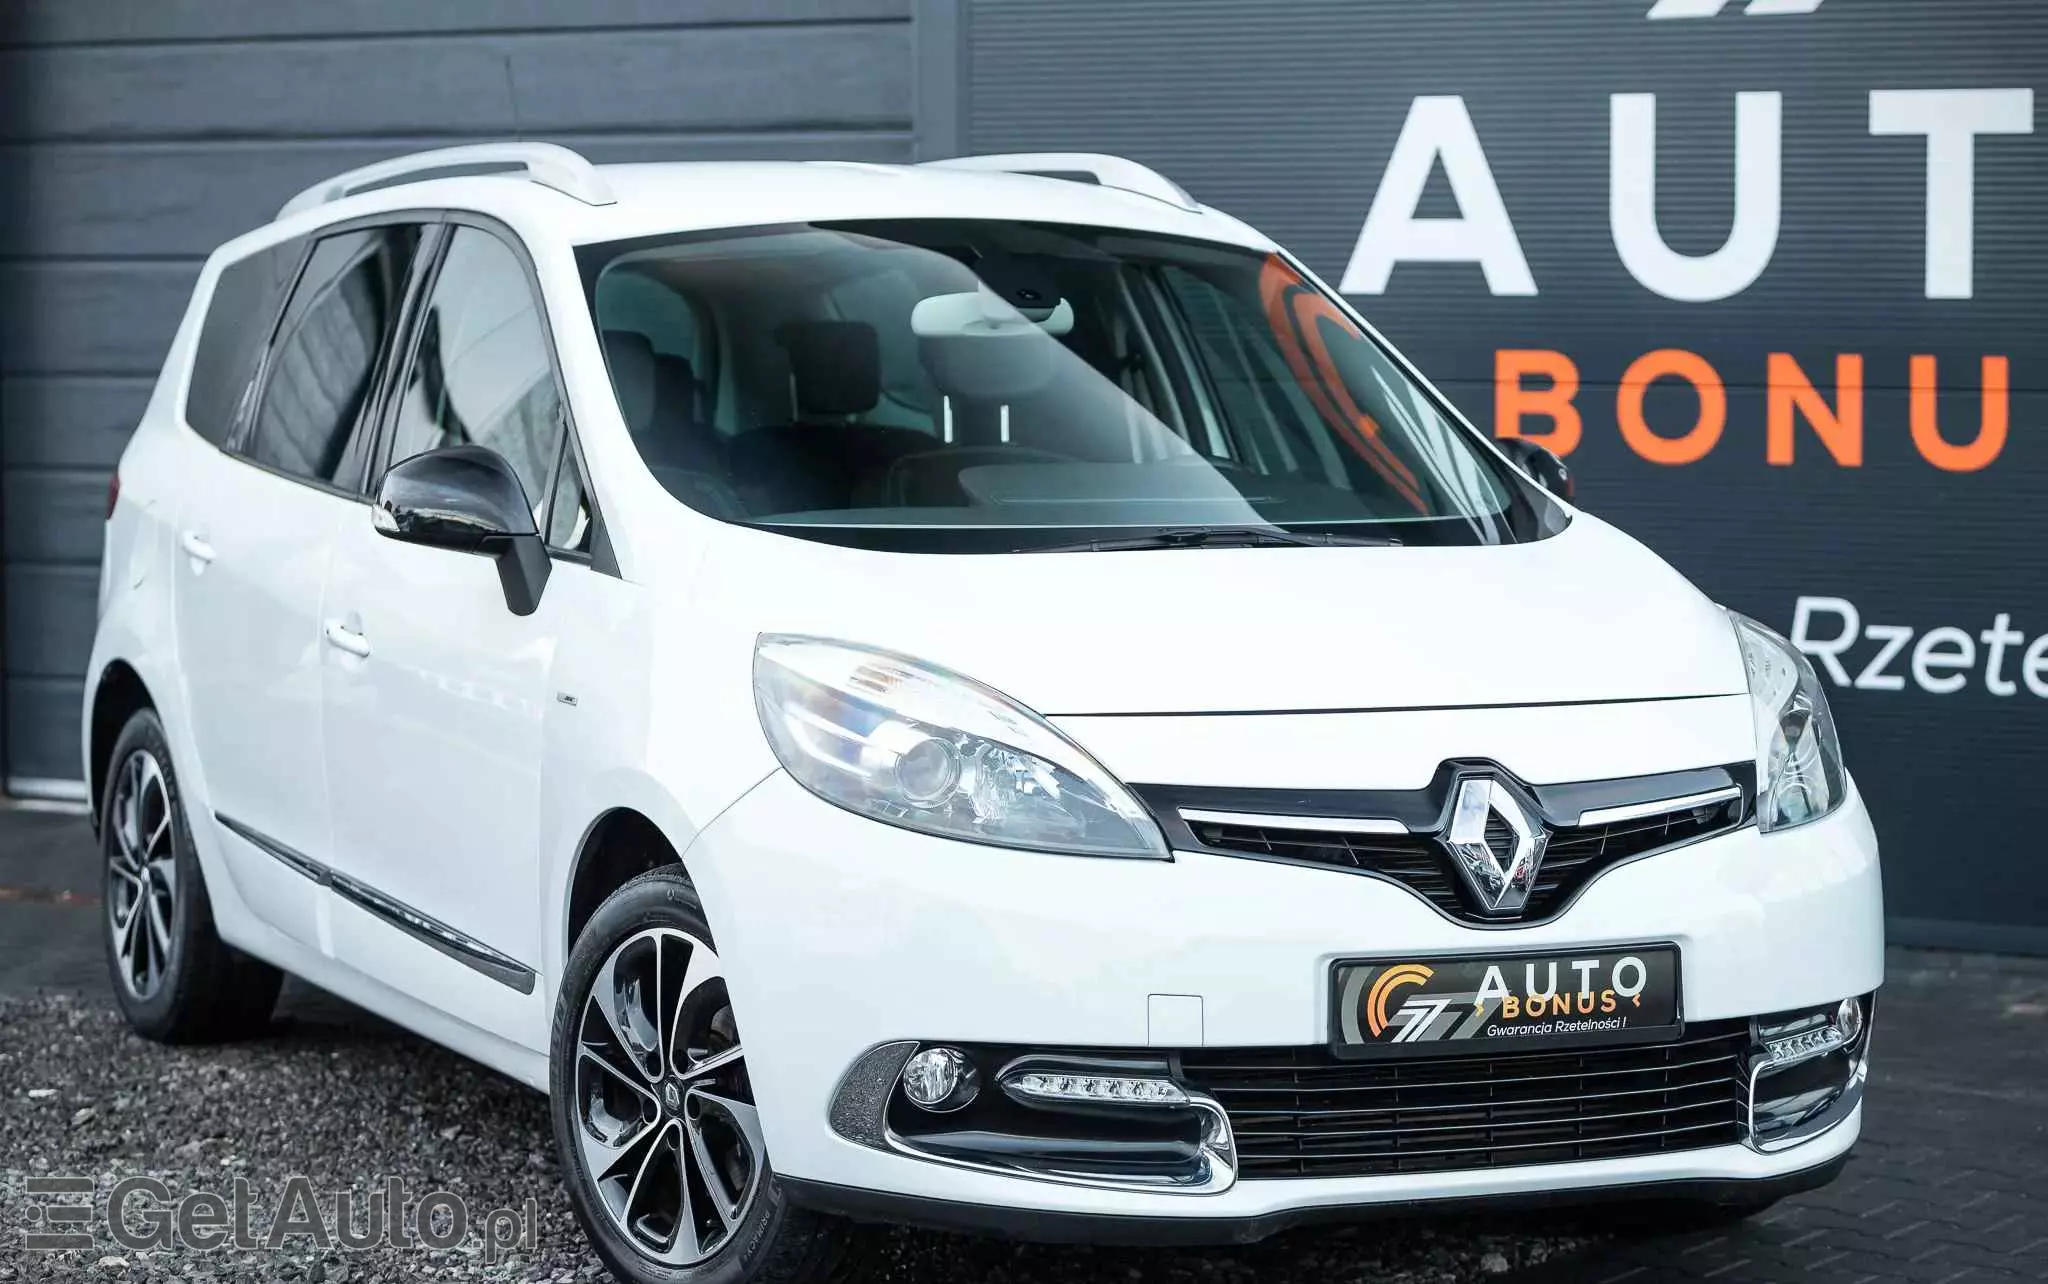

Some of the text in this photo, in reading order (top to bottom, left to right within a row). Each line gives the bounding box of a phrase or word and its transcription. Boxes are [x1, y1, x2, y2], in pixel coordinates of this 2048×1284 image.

[1338, 88, 2034, 302] AUT
[1494, 349, 2010, 472] BONU
[1473, 956, 1647, 1007] AUTO
[1502, 989, 1617, 1019] BONUS
[1487, 1021, 1552, 1037] Gwarancja
[1555, 1016, 1620, 1034] Rzetelności
